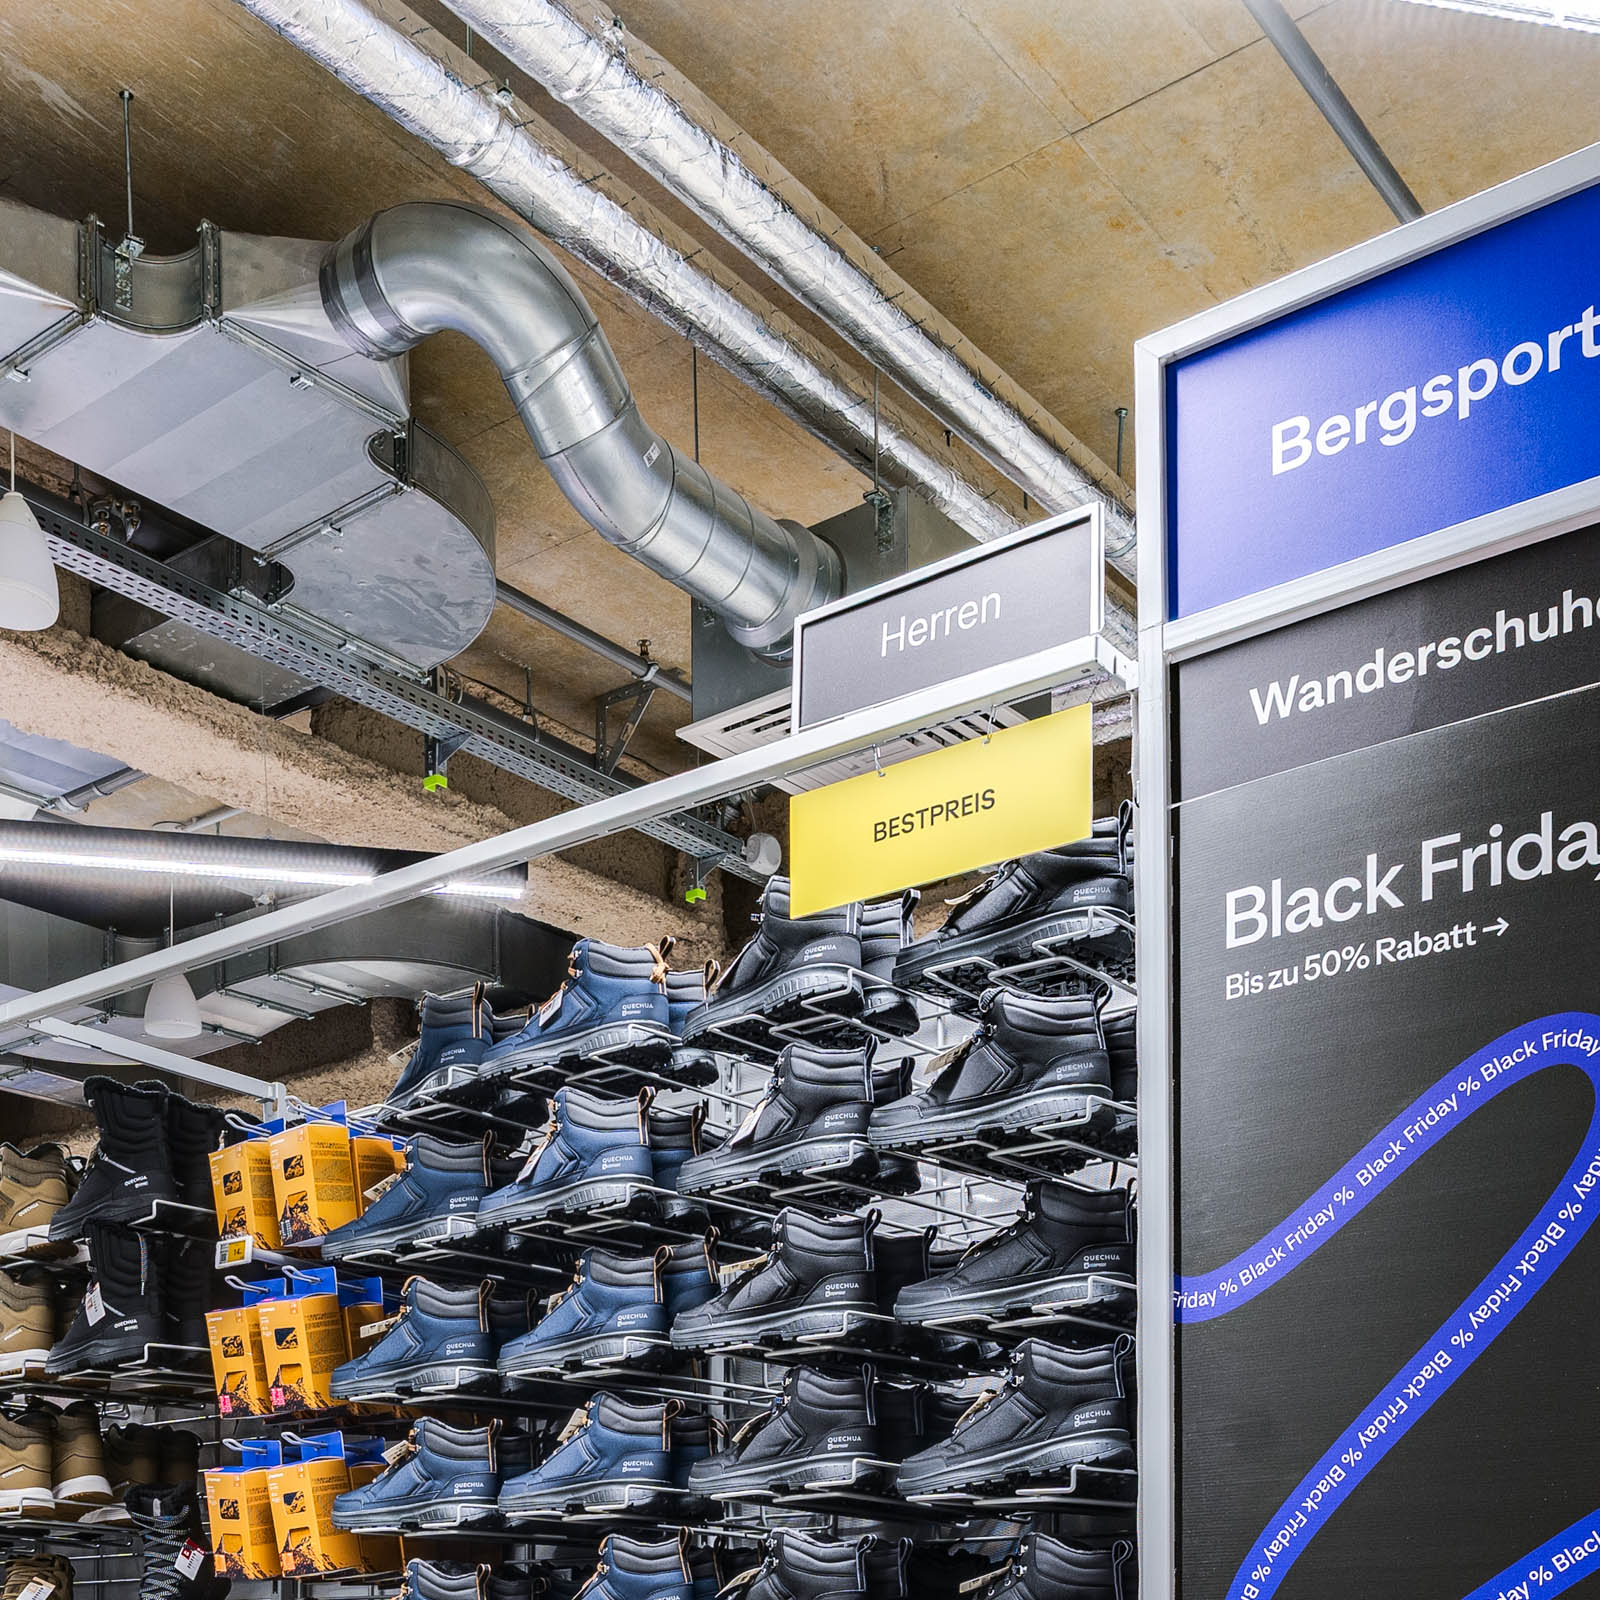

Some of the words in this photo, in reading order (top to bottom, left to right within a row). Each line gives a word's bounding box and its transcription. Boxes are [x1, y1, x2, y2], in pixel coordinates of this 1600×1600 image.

[881, 592, 1000, 657] Herren
[873, 789, 996, 843] BESTPREIS
[1074, 888, 1111, 897] QUECHUA
[1225, 860, 1404, 951] Black
[805, 945, 836, 954] QUECHUA
[1225, 968, 1263, 1002] Bis
[1266, 962, 1299, 991] zu
[1303, 943, 1371, 982] 50%
[1374, 921, 1477, 966] Rabatt
[441, 1049, 465, 1057] QUECHUA
[1056, 1063, 1094, 1073] QUECHUA
[1480, 1040, 1537, 1084] Black
[1457, 1076, 1481, 1096] %
[825, 1113, 858, 1121] QUECHUA
[1404, 1093, 1459, 1145] Friday
[1356, 1143, 1407, 1187] Black
[1333, 1187, 1354, 1205] %
[1558, 1202, 1583, 1222] %
[1284, 1205, 1336, 1251] Friday
[1517, 1223, 1565, 1276] Black
[1239, 1246, 1286, 1287] Black
[1219, 1279, 1238, 1296] %
[1468, 1274, 1522, 1328] Friday
[1451, 1328, 1474, 1348] %
[1402, 1350, 1452, 1398] Black
[1075, 1411, 1112, 1420] QUECHUA
[1358, 1397, 1407, 1448] Friday
[828, 1436, 861, 1444] QUECHUA
[1342, 1447, 1363, 1467] %
[1302, 1465, 1345, 1510] Black
[1264, 1509, 1308, 1563] Friday
[1252, 1564, 1271, 1582] %
[1528, 1565, 1553, 1586] %
